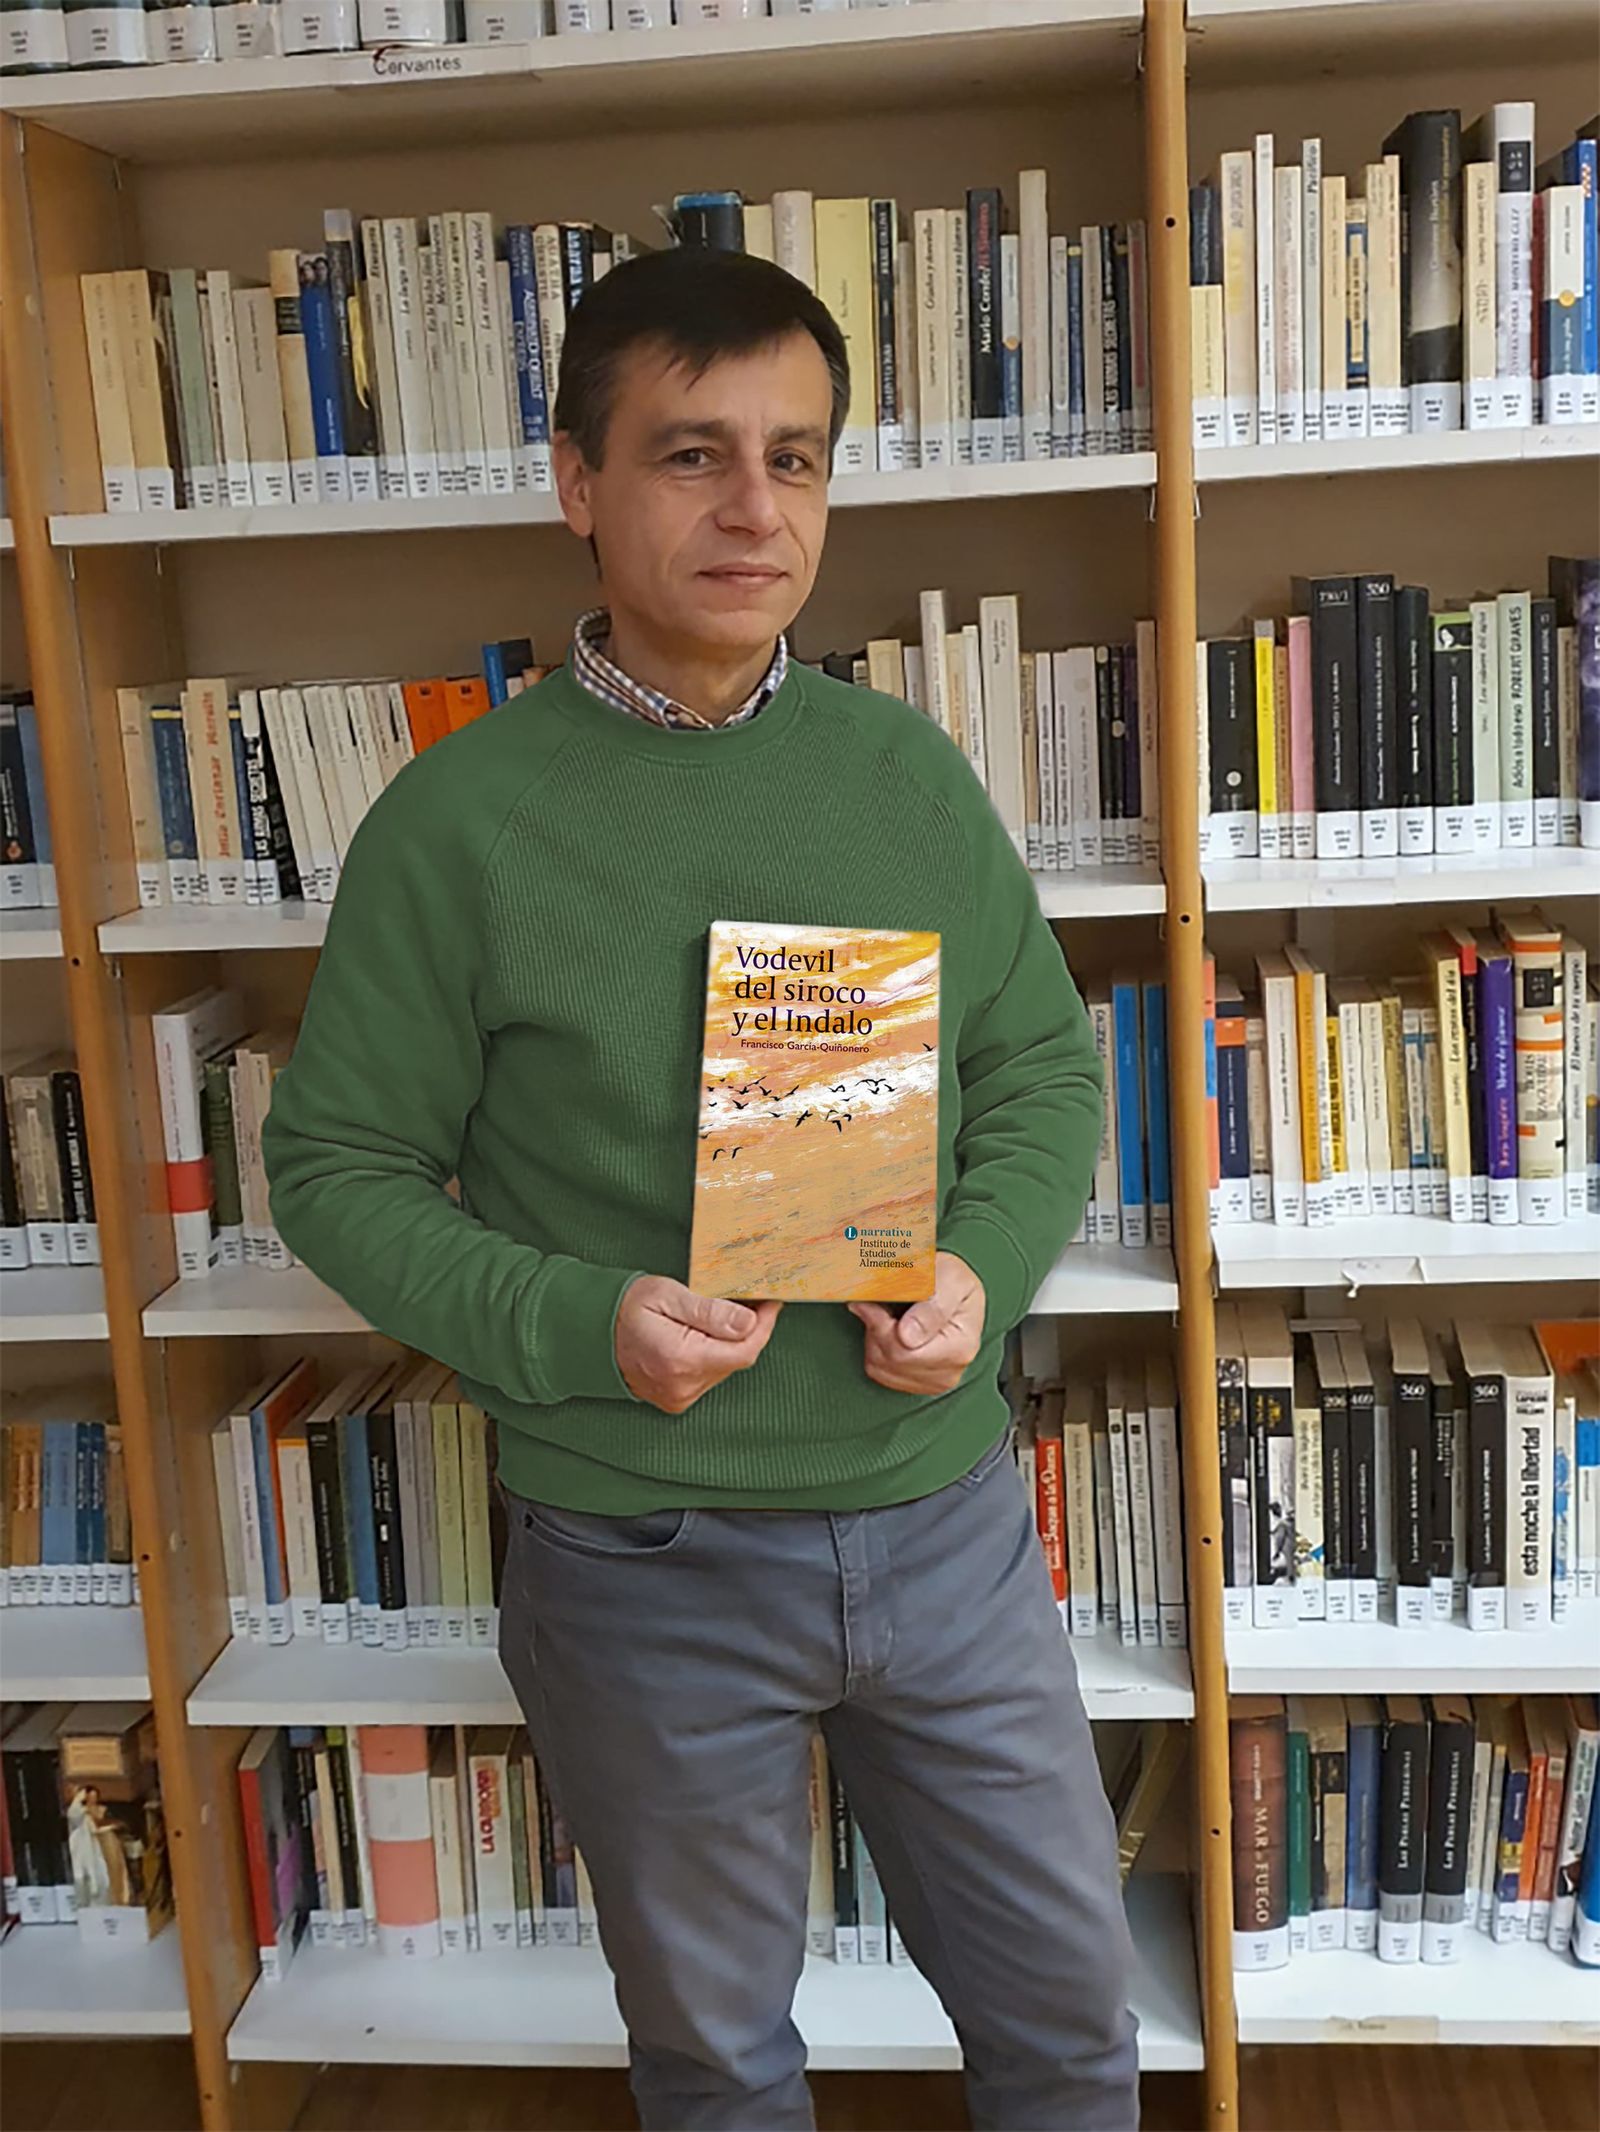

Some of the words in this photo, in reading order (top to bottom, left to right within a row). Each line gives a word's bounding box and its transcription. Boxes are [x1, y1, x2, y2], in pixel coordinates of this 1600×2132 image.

[373, 56, 462, 75] Cervantes
[979, 314, 991, 353] Mario
[1508, 606, 1522, 653] GRAVES
[1509, 654, 1522, 699] ROBERT
[1512, 759, 1524, 788] Adiós
[735, 945, 835, 973] Vodevil
[735, 975, 776, 1001] del
[783, 980, 866, 1005] siroco
[731, 1011, 748, 1036] y
[754, 1007, 777, 1032] el
[785, 1009, 873, 1035] Indalo
[741, 1039, 784, 1051] Francisco
[787, 1040, 870, 1054] García-Quiñonero
[860, 1228, 912, 1238] narrativa
[860, 1239, 899, 1249] Instituto
[900, 1240, 911, 1249] de
[859, 1249, 896, 1259] Estudios
[859, 1259, 914, 1269] Almerienses
[1400, 1384, 1425, 1396] 360
[1474, 1385, 1499, 1398] 360
[1520, 1427, 1540, 1482] libertad
[1521, 1484, 1539, 1497] la
[1520, 1499, 1539, 1543] noche
[1520, 1545, 1539, 1576] esta
[1254, 1806, 1268, 1848] MAR
[1254, 1863, 1270, 1923] FUEGO
